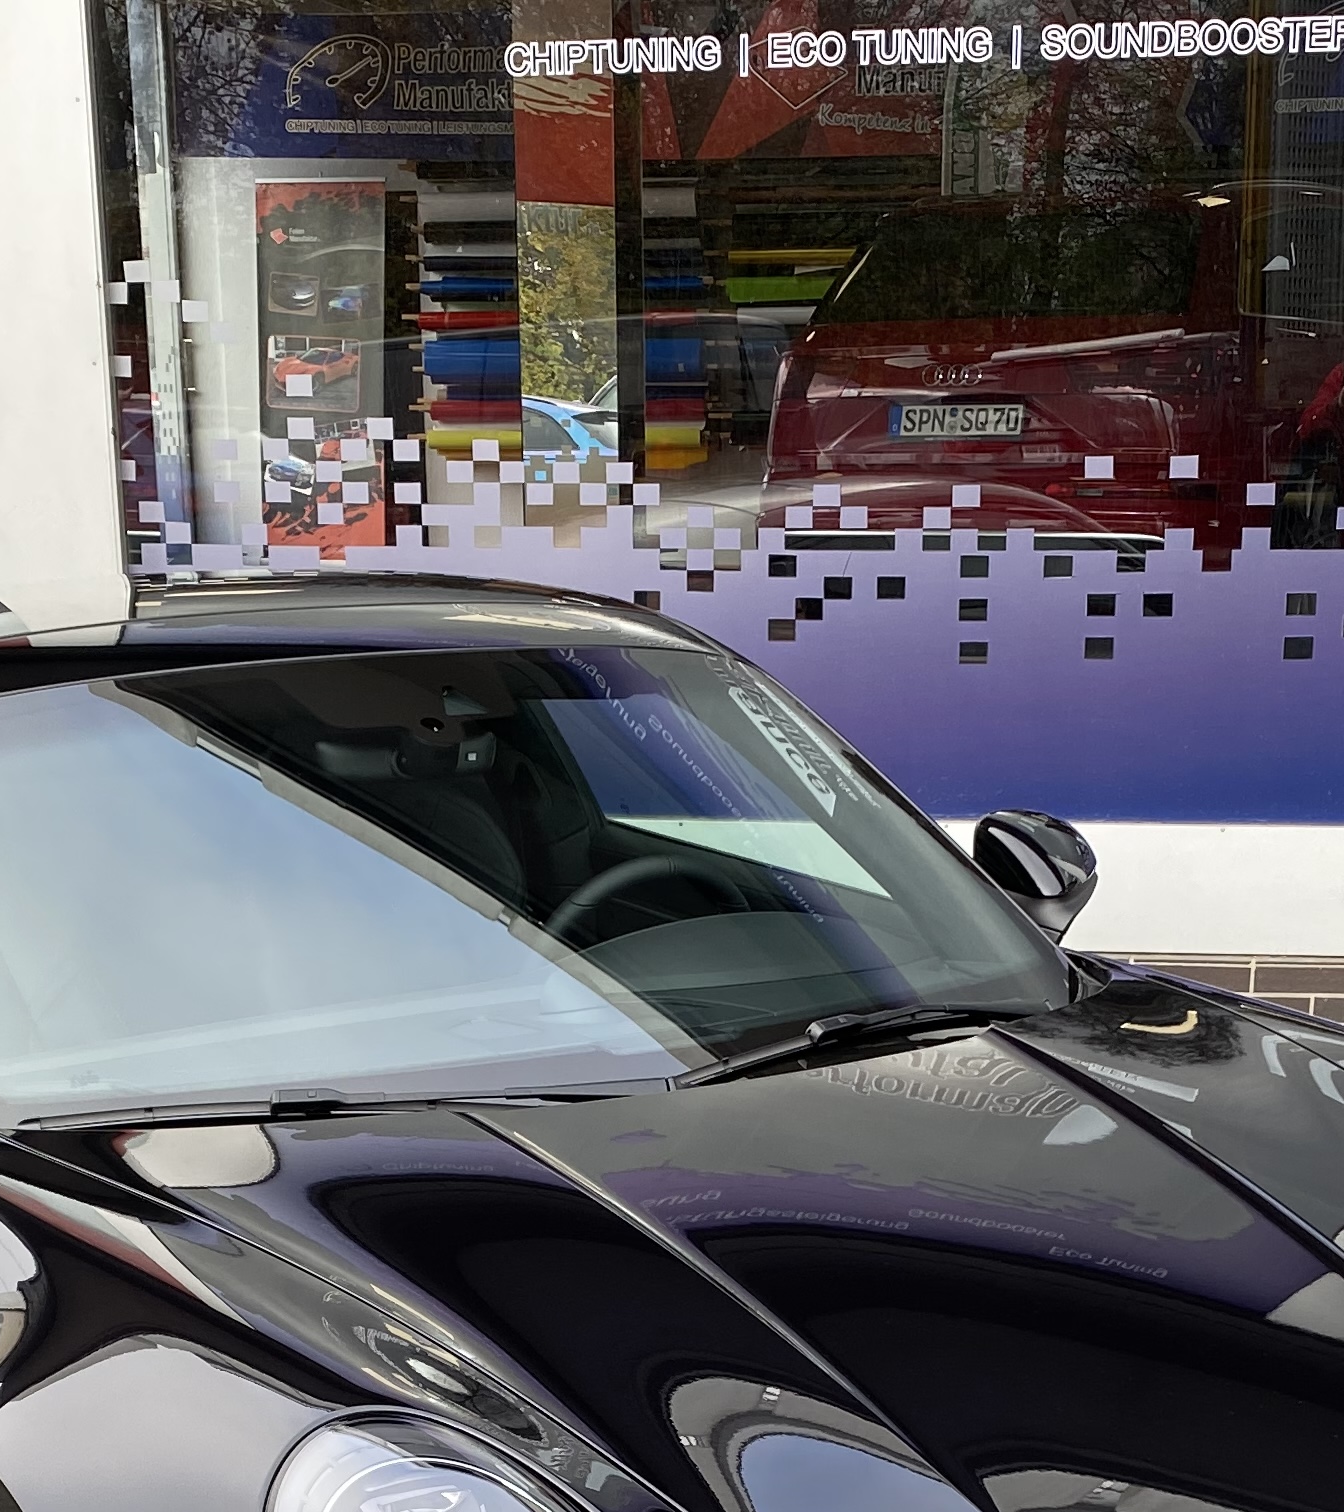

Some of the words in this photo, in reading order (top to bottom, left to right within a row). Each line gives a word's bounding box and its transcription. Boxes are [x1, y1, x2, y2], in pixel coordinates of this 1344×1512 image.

[504, 34, 722, 77] CHIPTUNING
[767, 29, 847, 69] ECO
[852, 26, 993, 65] TUNING
[285, 119, 356, 133] CHIPTUNING
[903, 408, 946, 432] SPN
